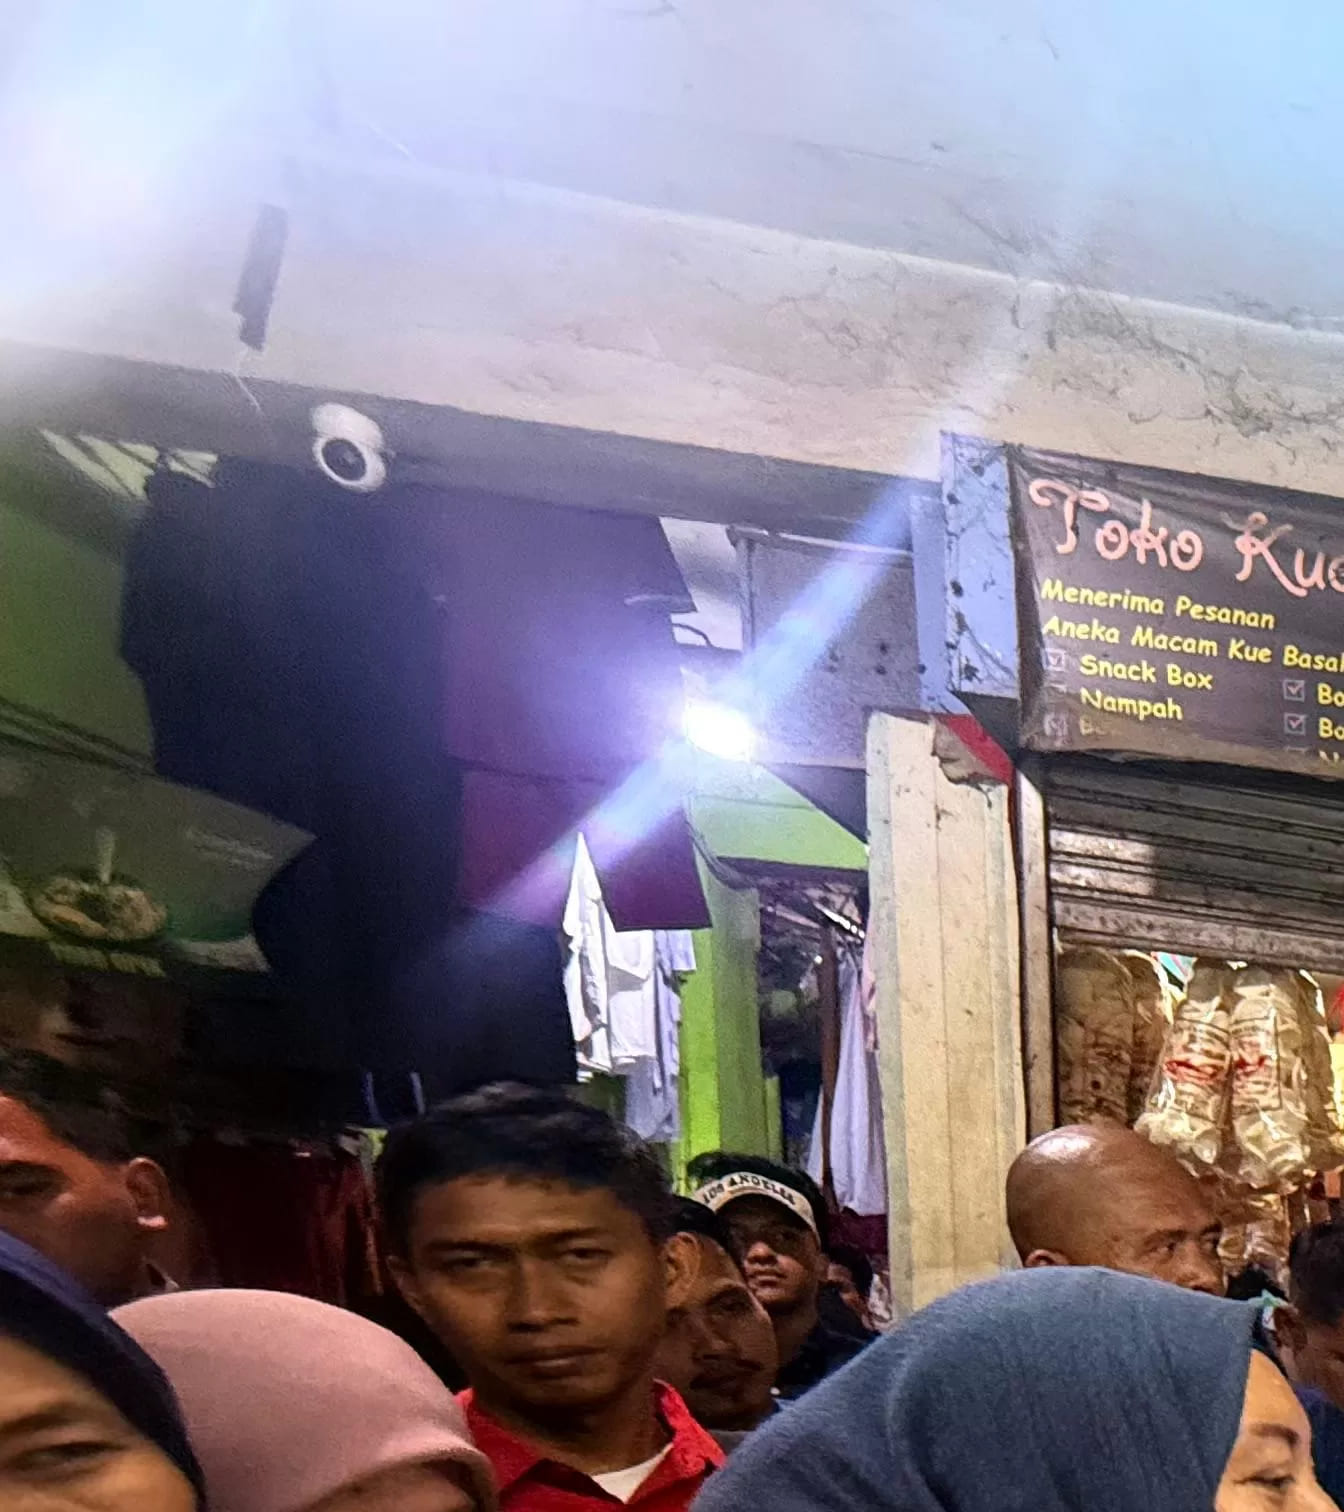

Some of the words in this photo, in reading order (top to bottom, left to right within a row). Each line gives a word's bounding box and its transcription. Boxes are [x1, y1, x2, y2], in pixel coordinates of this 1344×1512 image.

[1028, 478, 1203, 571] Toko
[1041, 579, 1164, 615] Menerima
[1175, 595, 1275, 630] Pesanan
[1042, 615, 1120, 645] Aneka
[1131, 626, 1218, 657] Macam
[1228, 638, 1272, 663] Kue
[1080, 654, 1156, 684] Snack
[1167, 663, 1213, 690] Box
[1080, 688, 1183, 721] Nampah
